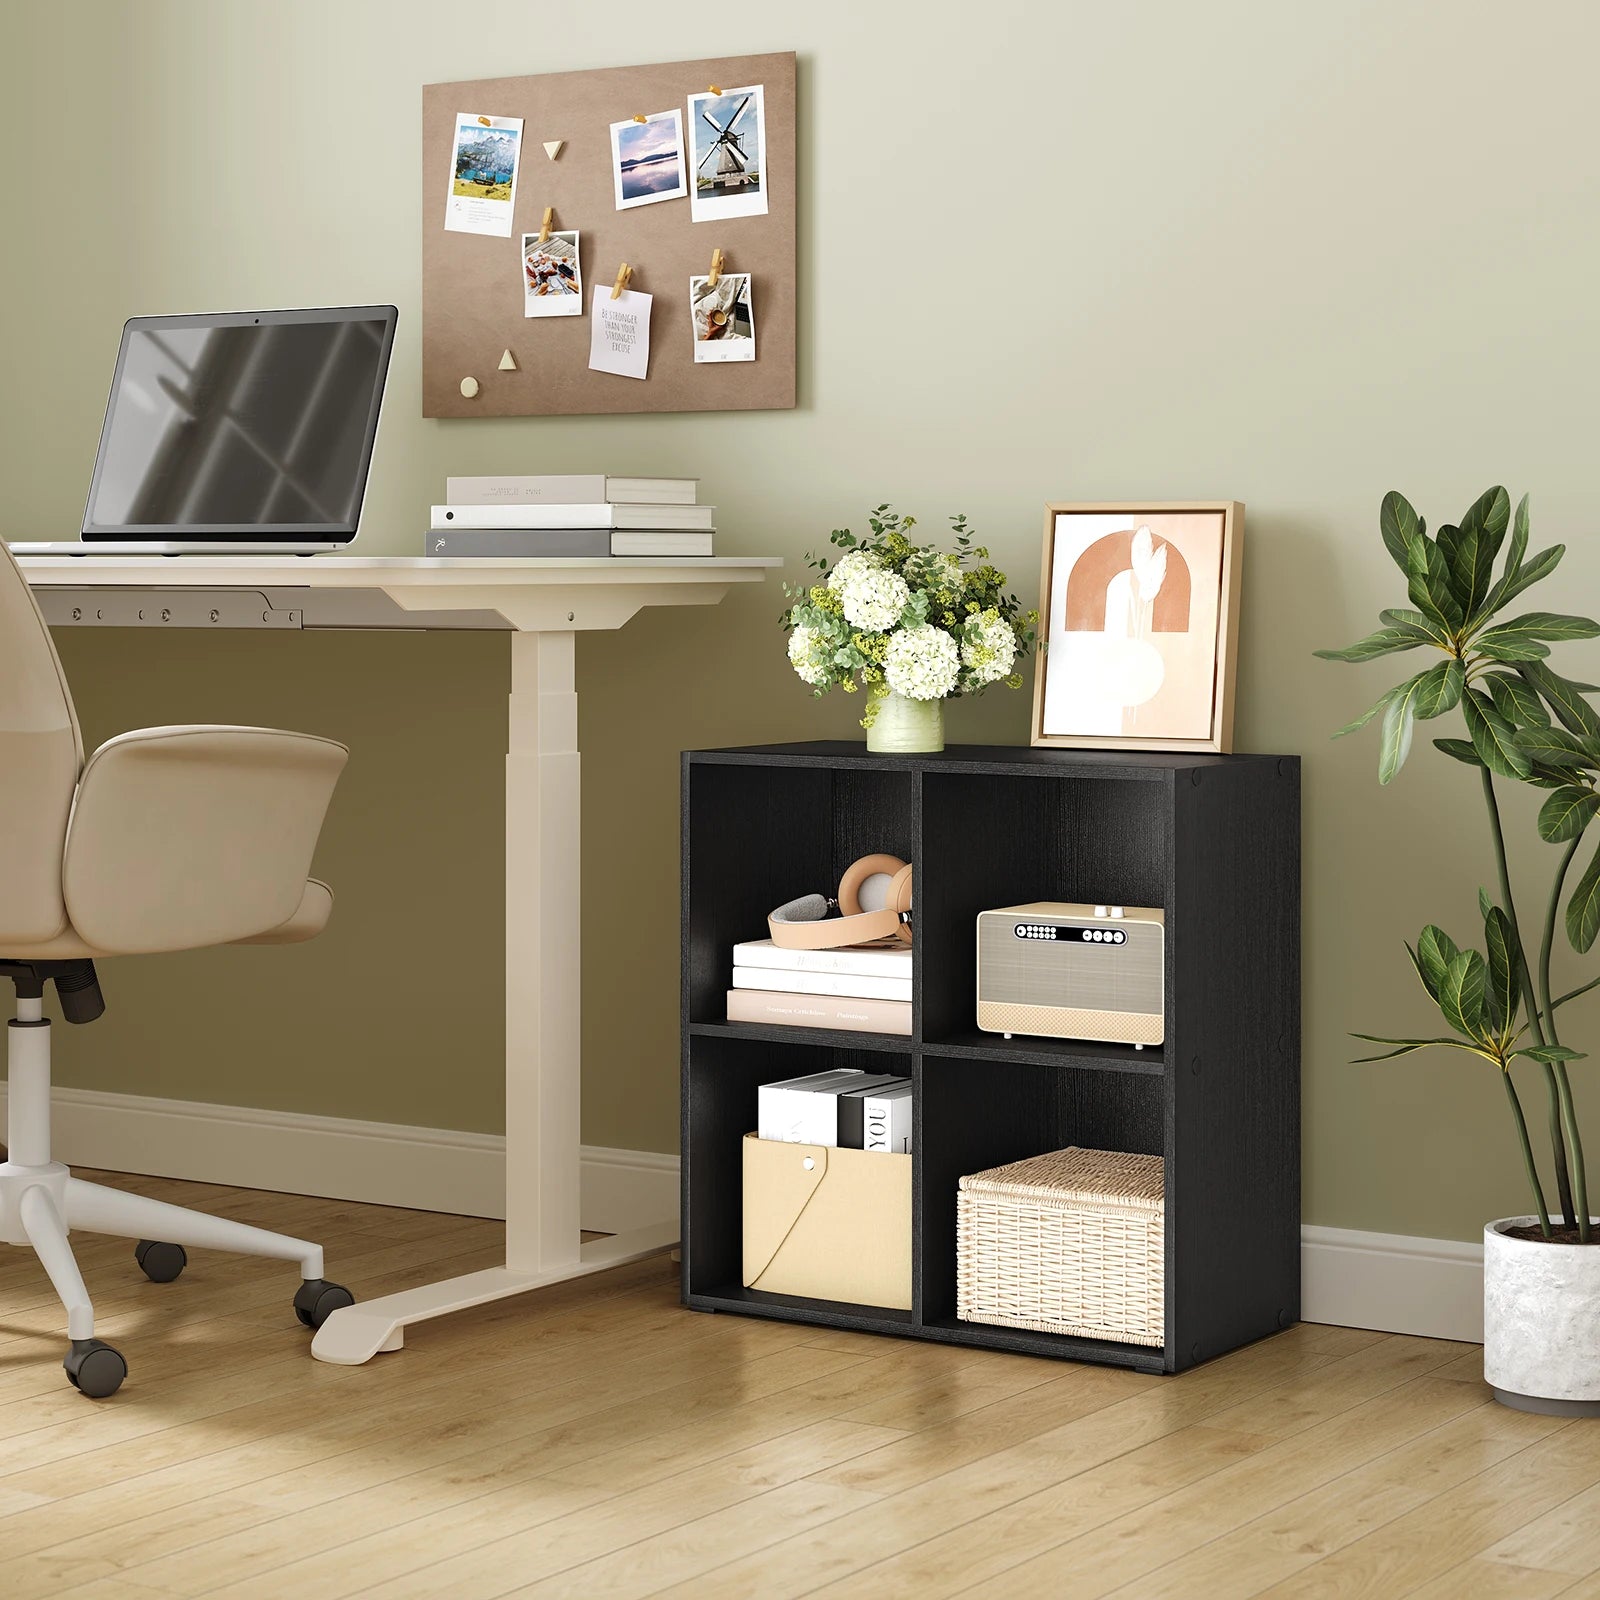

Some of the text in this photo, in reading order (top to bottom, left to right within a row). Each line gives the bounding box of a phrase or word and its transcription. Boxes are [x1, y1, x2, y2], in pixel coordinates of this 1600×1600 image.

[601, 308, 638, 325] BE STRONGER
[604, 320, 636, 334] THAN YOUR
[605, 330, 637, 345] STRONGEST
[611, 342, 632, 354] EXCUSE
[869, 1107, 887, 1149] YOU
